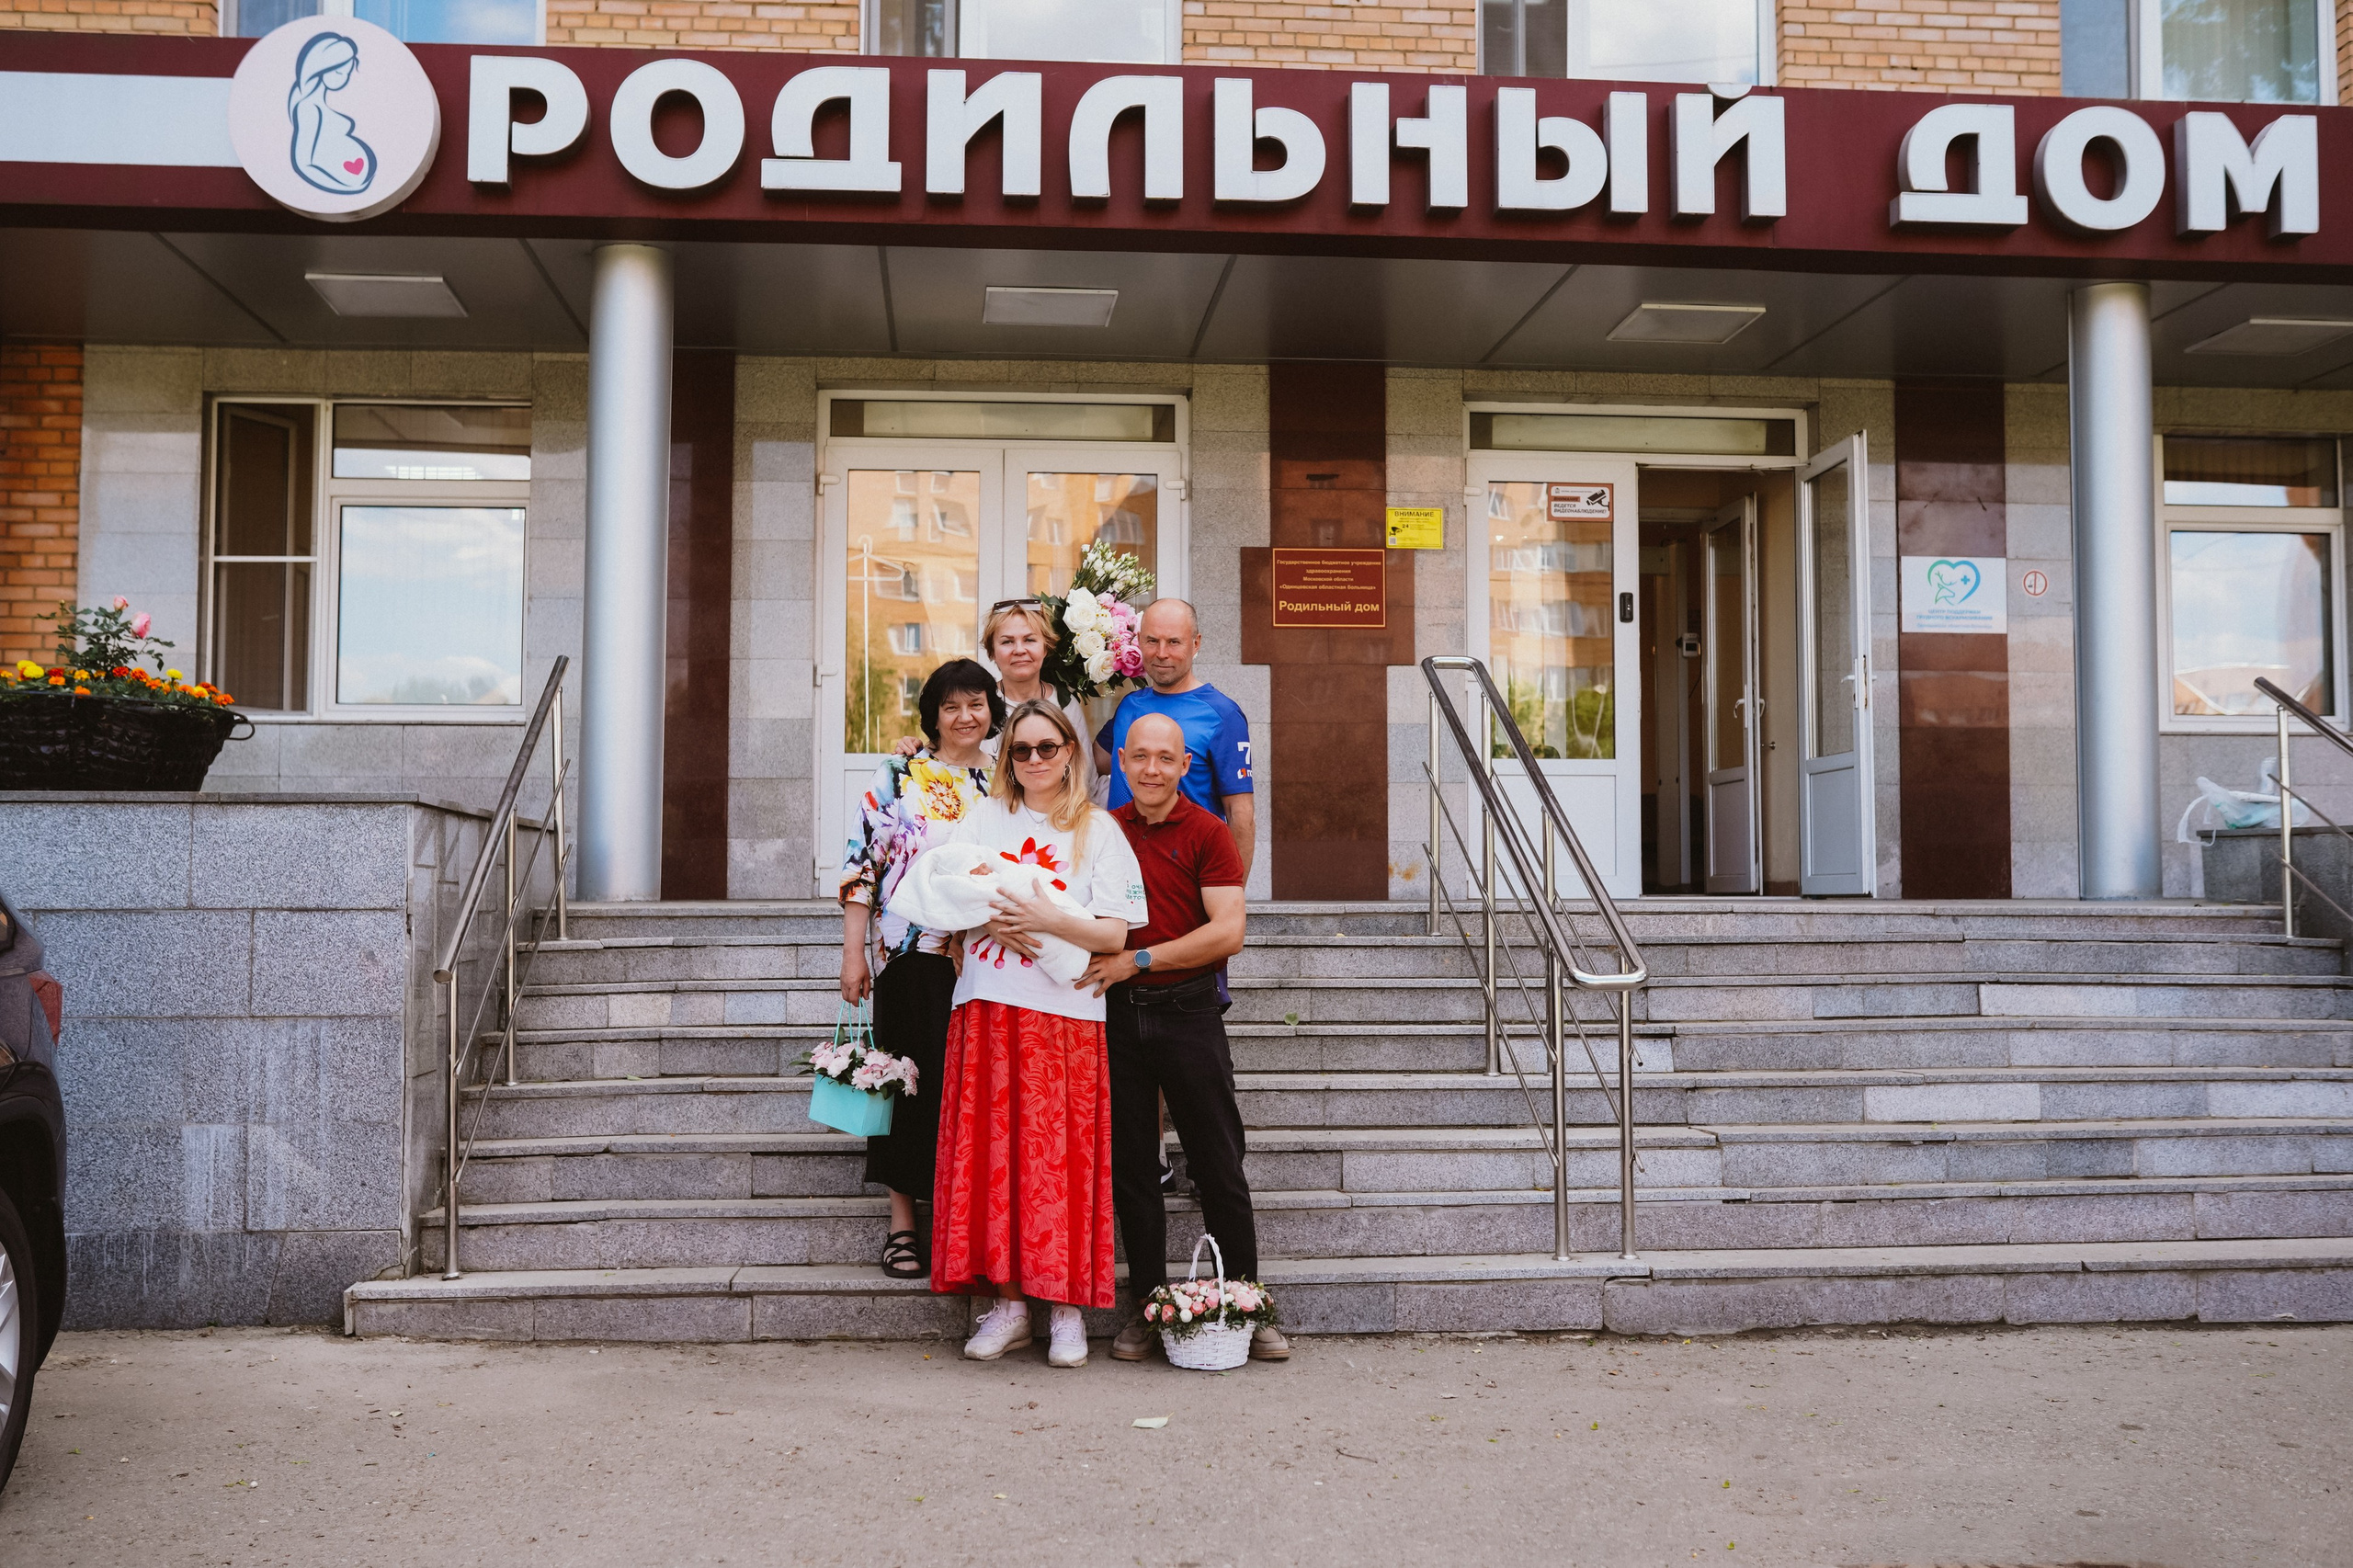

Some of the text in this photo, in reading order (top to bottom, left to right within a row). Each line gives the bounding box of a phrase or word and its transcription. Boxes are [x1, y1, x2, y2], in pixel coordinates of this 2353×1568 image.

[467, 55, 2320, 238] РОДИЛЬНЫЙ ДОМ
[1279, 600, 1380, 613] Родильный дом
